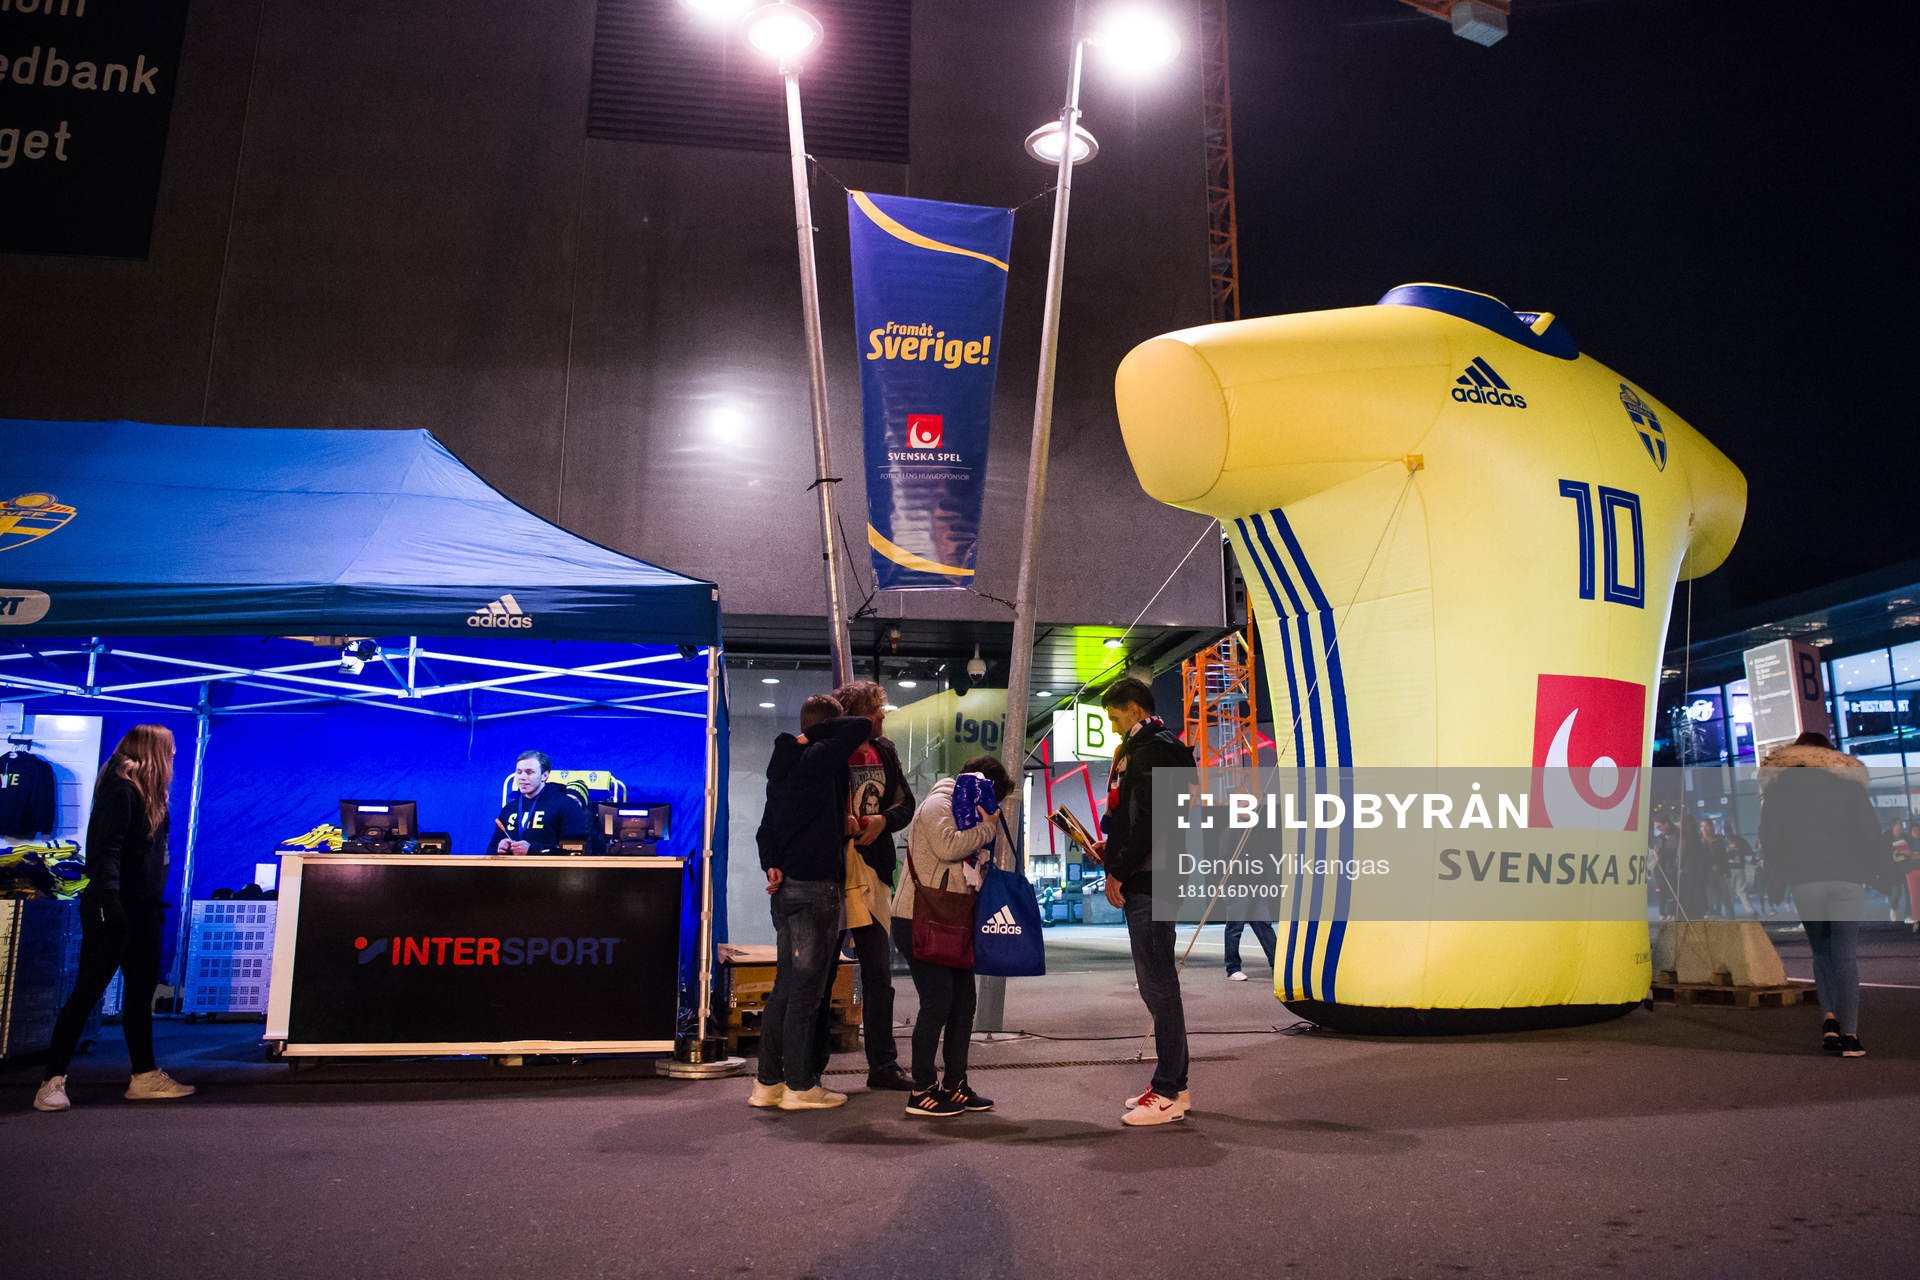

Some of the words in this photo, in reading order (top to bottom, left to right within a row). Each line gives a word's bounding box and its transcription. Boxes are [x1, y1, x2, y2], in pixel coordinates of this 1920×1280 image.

[885, 321, 934, 337] Framåt
[866, 328, 992, 369] Sverige!
[1451, 385, 1528, 410] adidas
[887, 452, 935, 461] SVENSKA
[937, 453, 963, 462] SPEL
[1558, 478, 1645, 609] 10
[466, 613, 533, 629] adidas
[1799, 652, 1820, 702] B
[1086, 712, 1105, 748] B
[1438, 848, 1620, 886] SVENSKA
[981, 923, 1022, 935] adidas
[391, 936, 622, 966] INTERSPORT
